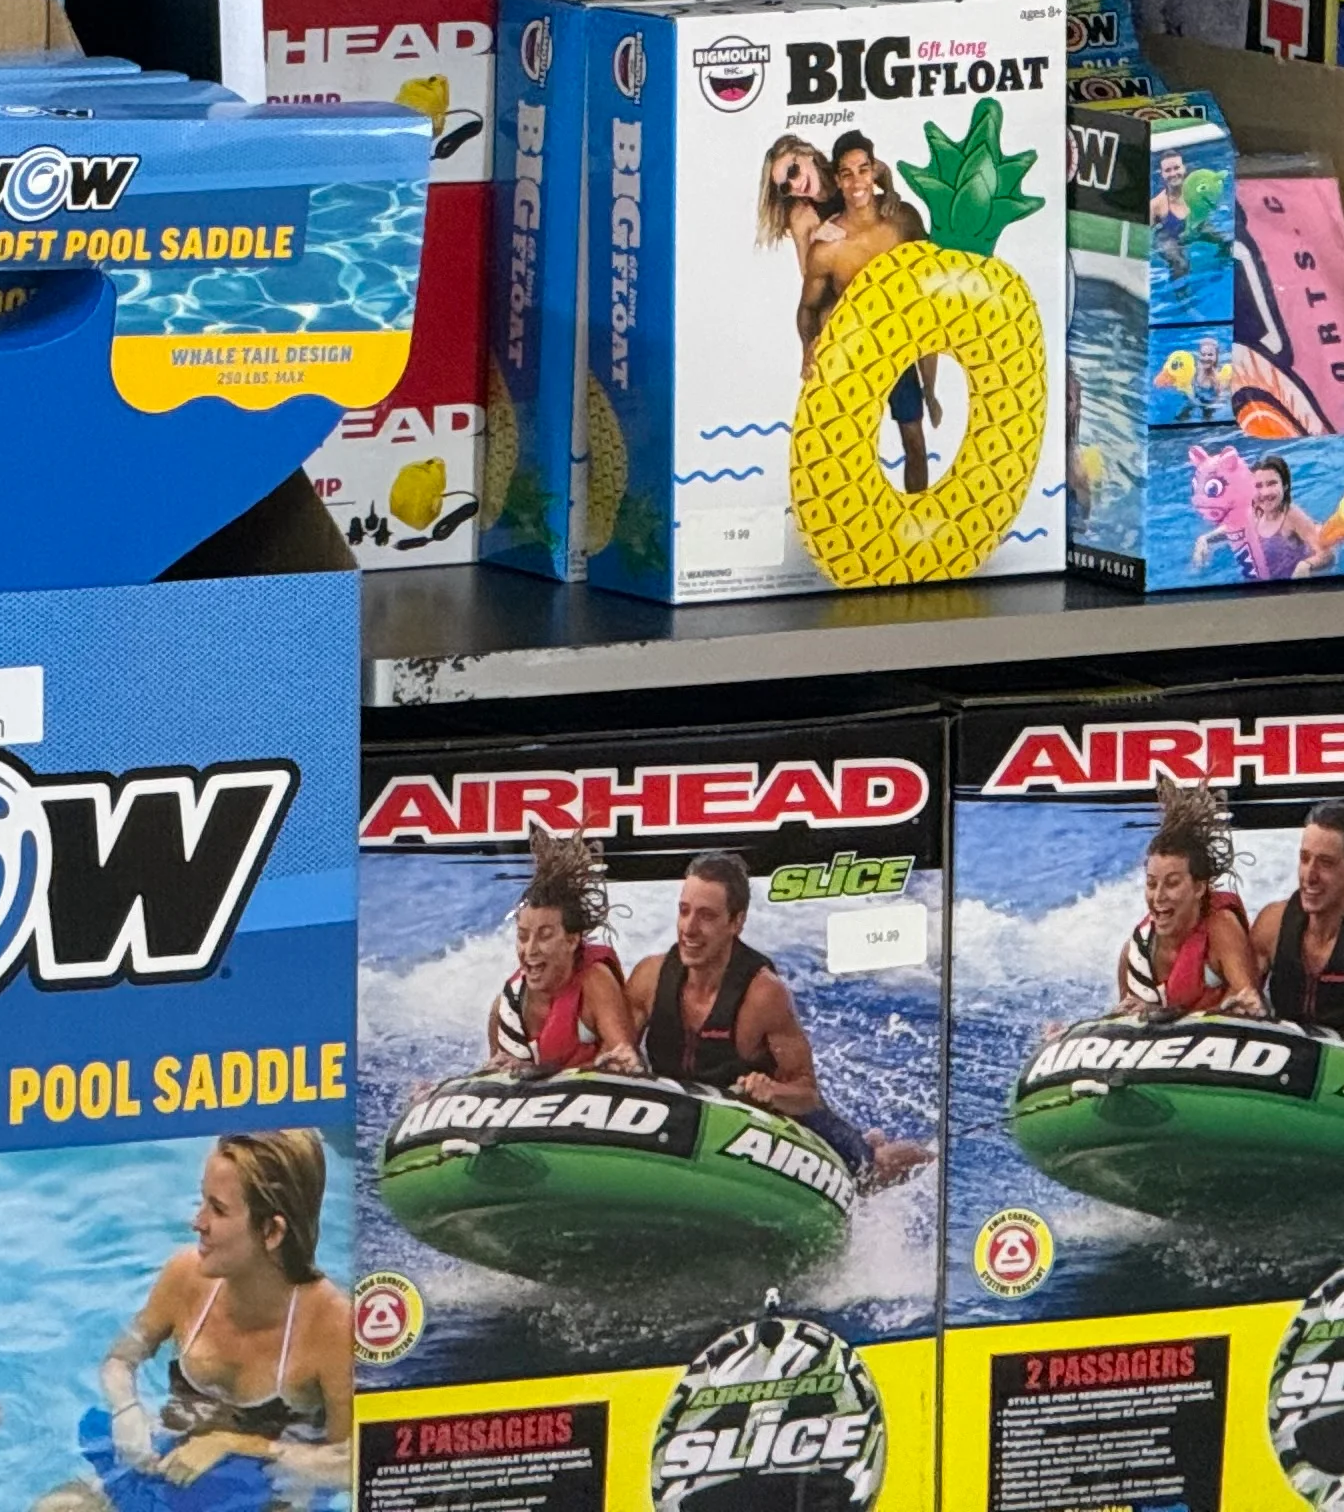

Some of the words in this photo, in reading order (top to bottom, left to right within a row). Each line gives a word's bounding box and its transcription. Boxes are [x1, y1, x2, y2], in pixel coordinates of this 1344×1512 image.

[695, 45, 769, 66] BIGMOUTH
[786, 37, 917, 106] BIG
[918, 41, 945, 58] 6ft.
[950, 39, 987, 58] long
[918, 57, 1049, 97] FLOAT
[786, 108, 855, 129] pineapple
[611, 117, 642, 250] BIG
[65, 226, 148, 262] POOL
[160, 224, 295, 261] SADDLE
[610, 251, 629, 391] FLOAT
[171, 346, 233, 366] WHALE
[239, 345, 282, 365] TAIL
[288, 344, 354, 364] DESIGN
[360, 759, 930, 845] AIRHEAD
[1032, 1035, 1291, 1082] AIRHEAD
[8, 1060, 141, 1126] POOL
[152, 1042, 348, 1114] SADDLE
[396, 1093, 668, 1143] AIRHEAD
[1025, 1359, 1043, 1389] 2
[1048, 1345, 1195, 1387] PASSAGERS
[395, 1426, 413, 1458] 2
[420, 1411, 573, 1456] PASSAGERS
